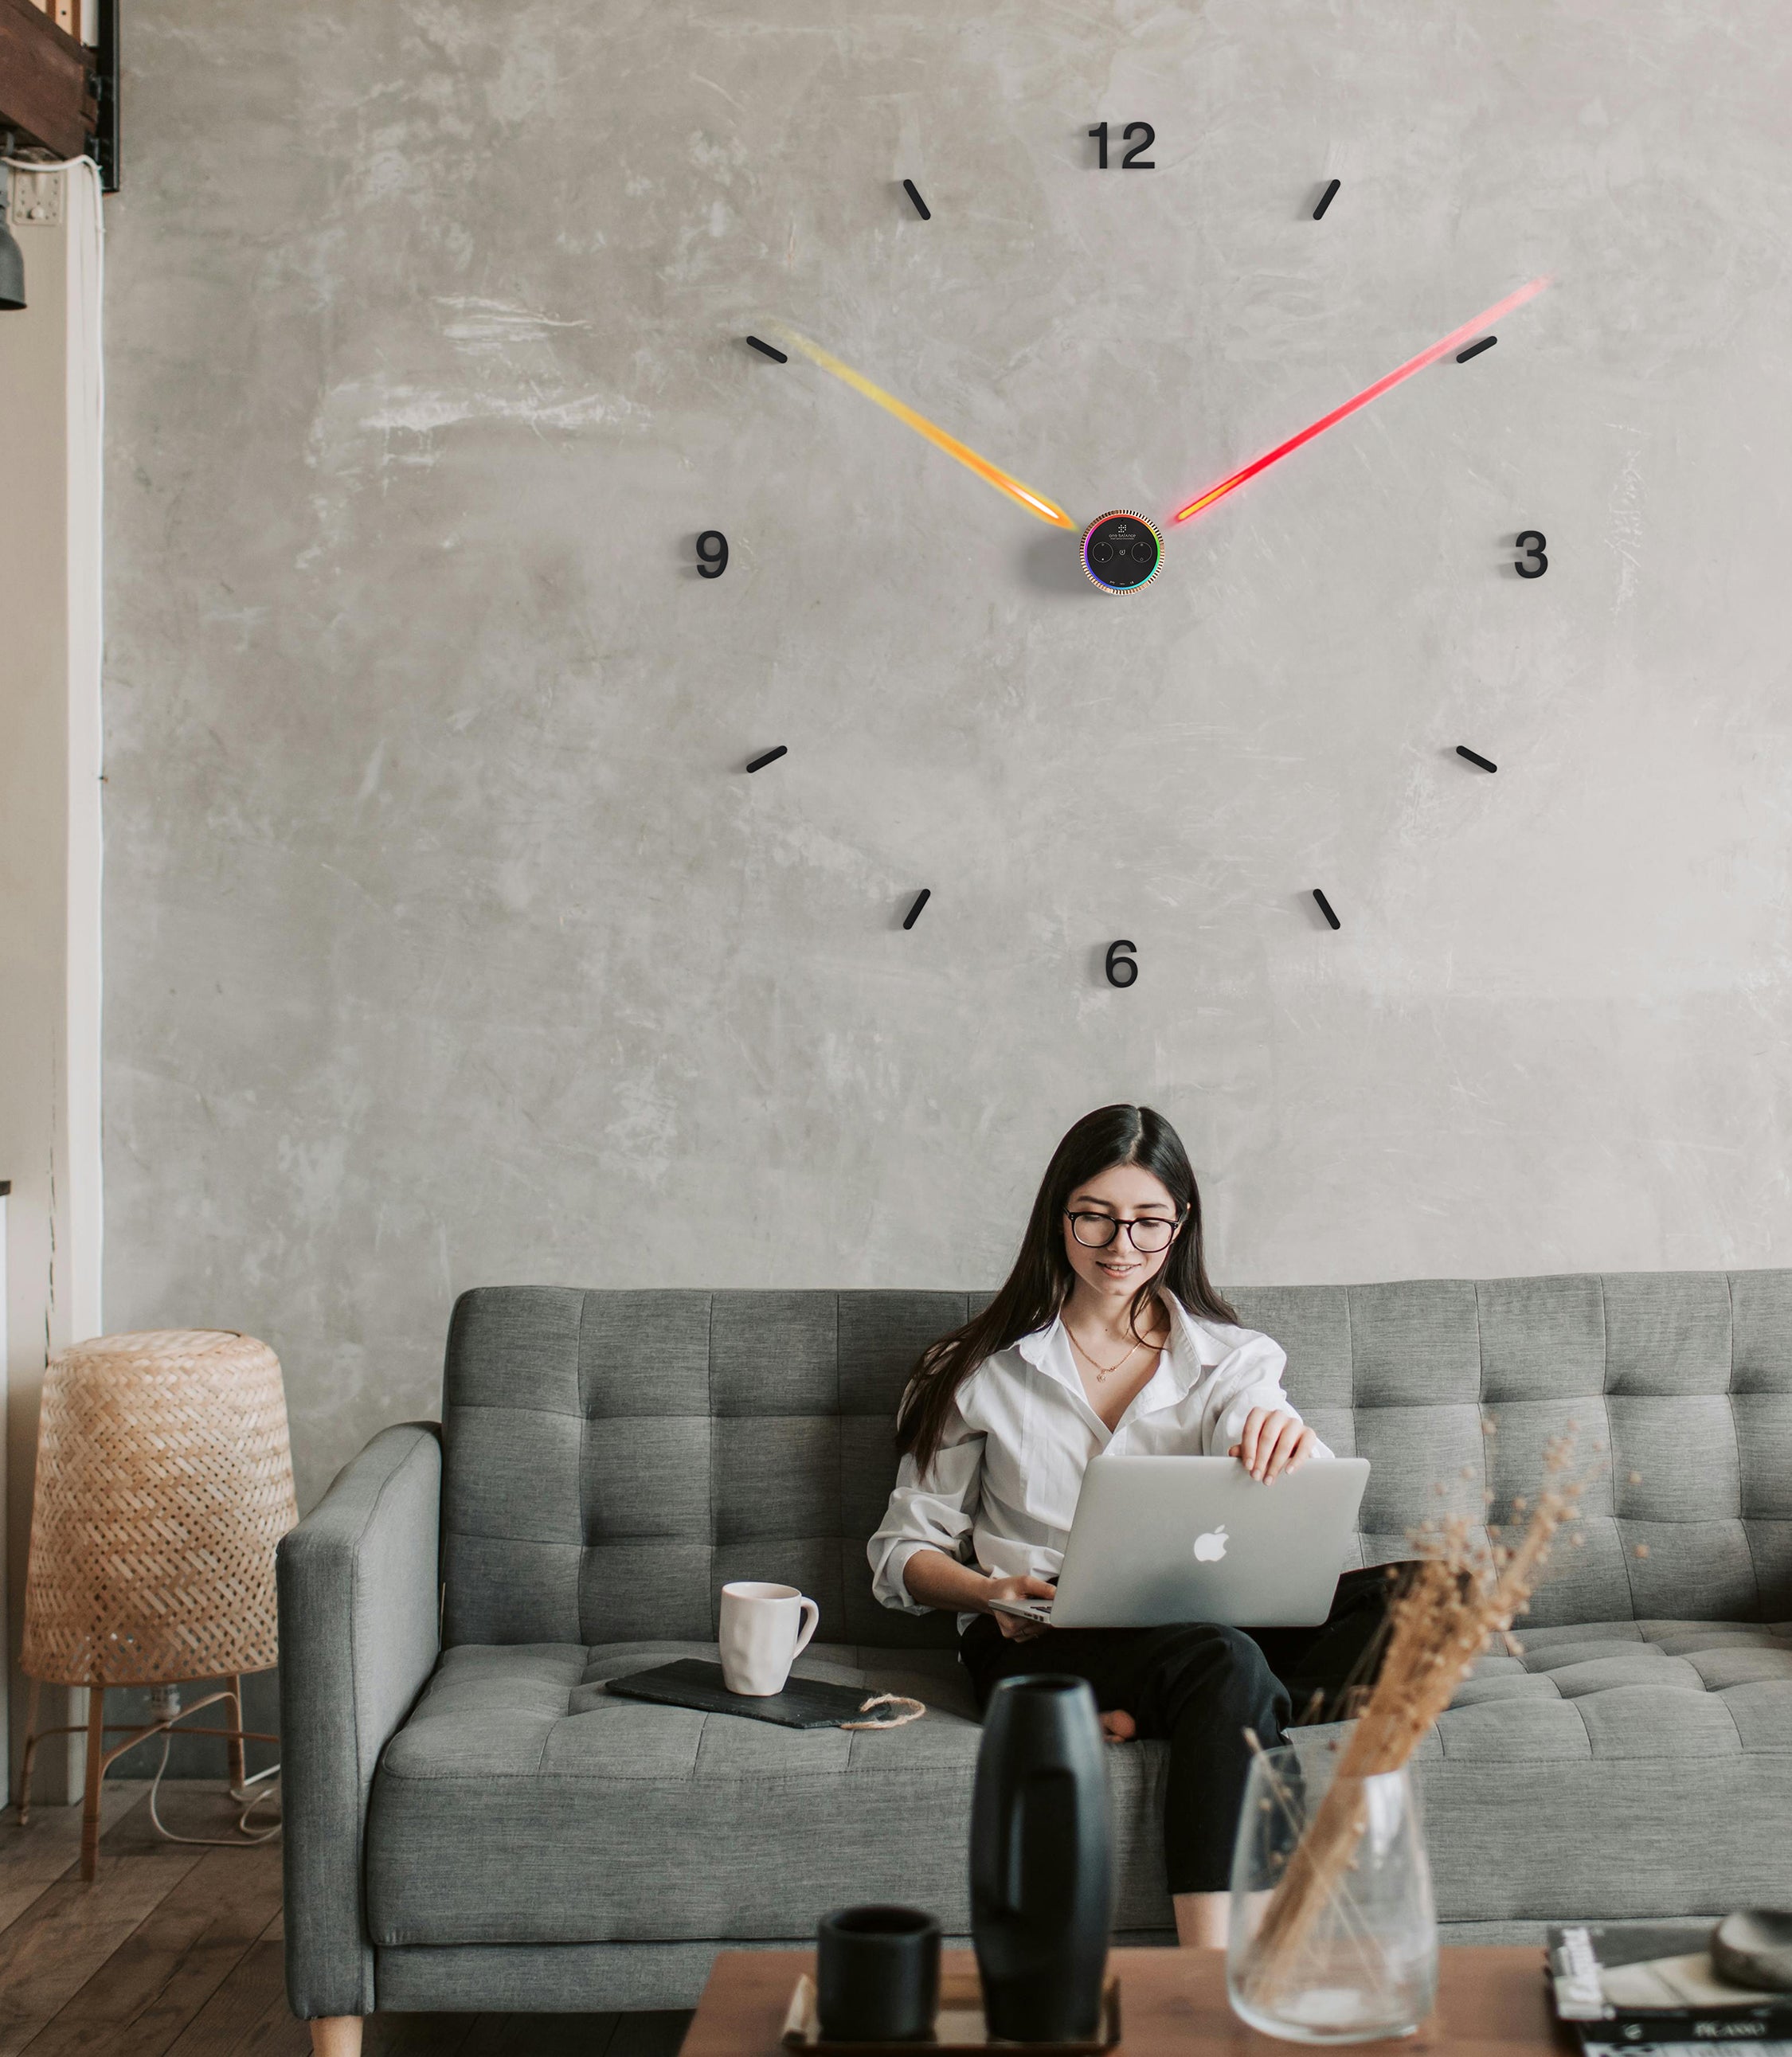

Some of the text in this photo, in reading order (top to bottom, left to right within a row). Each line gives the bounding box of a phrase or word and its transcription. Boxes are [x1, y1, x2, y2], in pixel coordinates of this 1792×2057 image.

[1089, 122, 1155, 169] 12
[696, 530, 729, 579] 9
[1515, 530, 1547, 579] 3
[1105, 940, 1137, 987] 6
